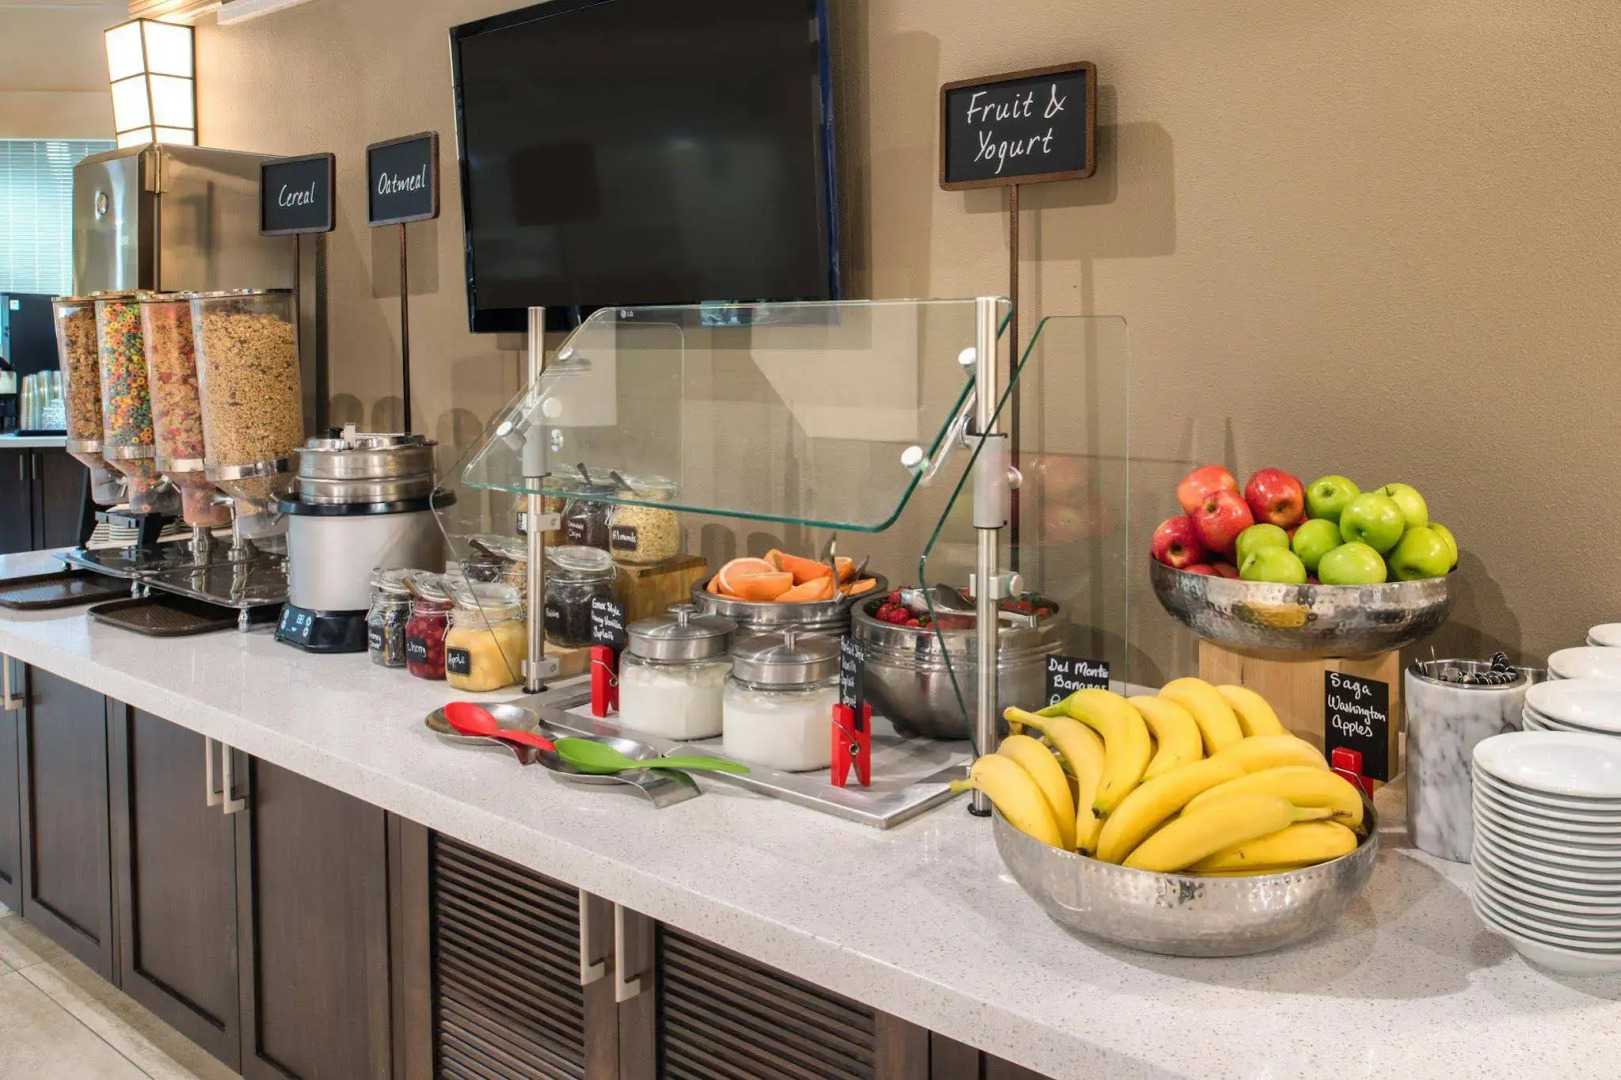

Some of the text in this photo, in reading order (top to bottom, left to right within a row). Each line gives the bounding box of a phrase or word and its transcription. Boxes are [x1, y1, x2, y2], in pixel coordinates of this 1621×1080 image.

[967, 83, 1066, 124] Fruit &
[974, 127, 1053, 175] Yogurt
[278, 182, 316, 207] Cereal
[378, 164, 427, 195] Oatmeal
[1048, 658, 1109, 679] Del Monte
[1330, 672, 1372, 700] Saga
[1327, 694, 1386, 725] Washington
